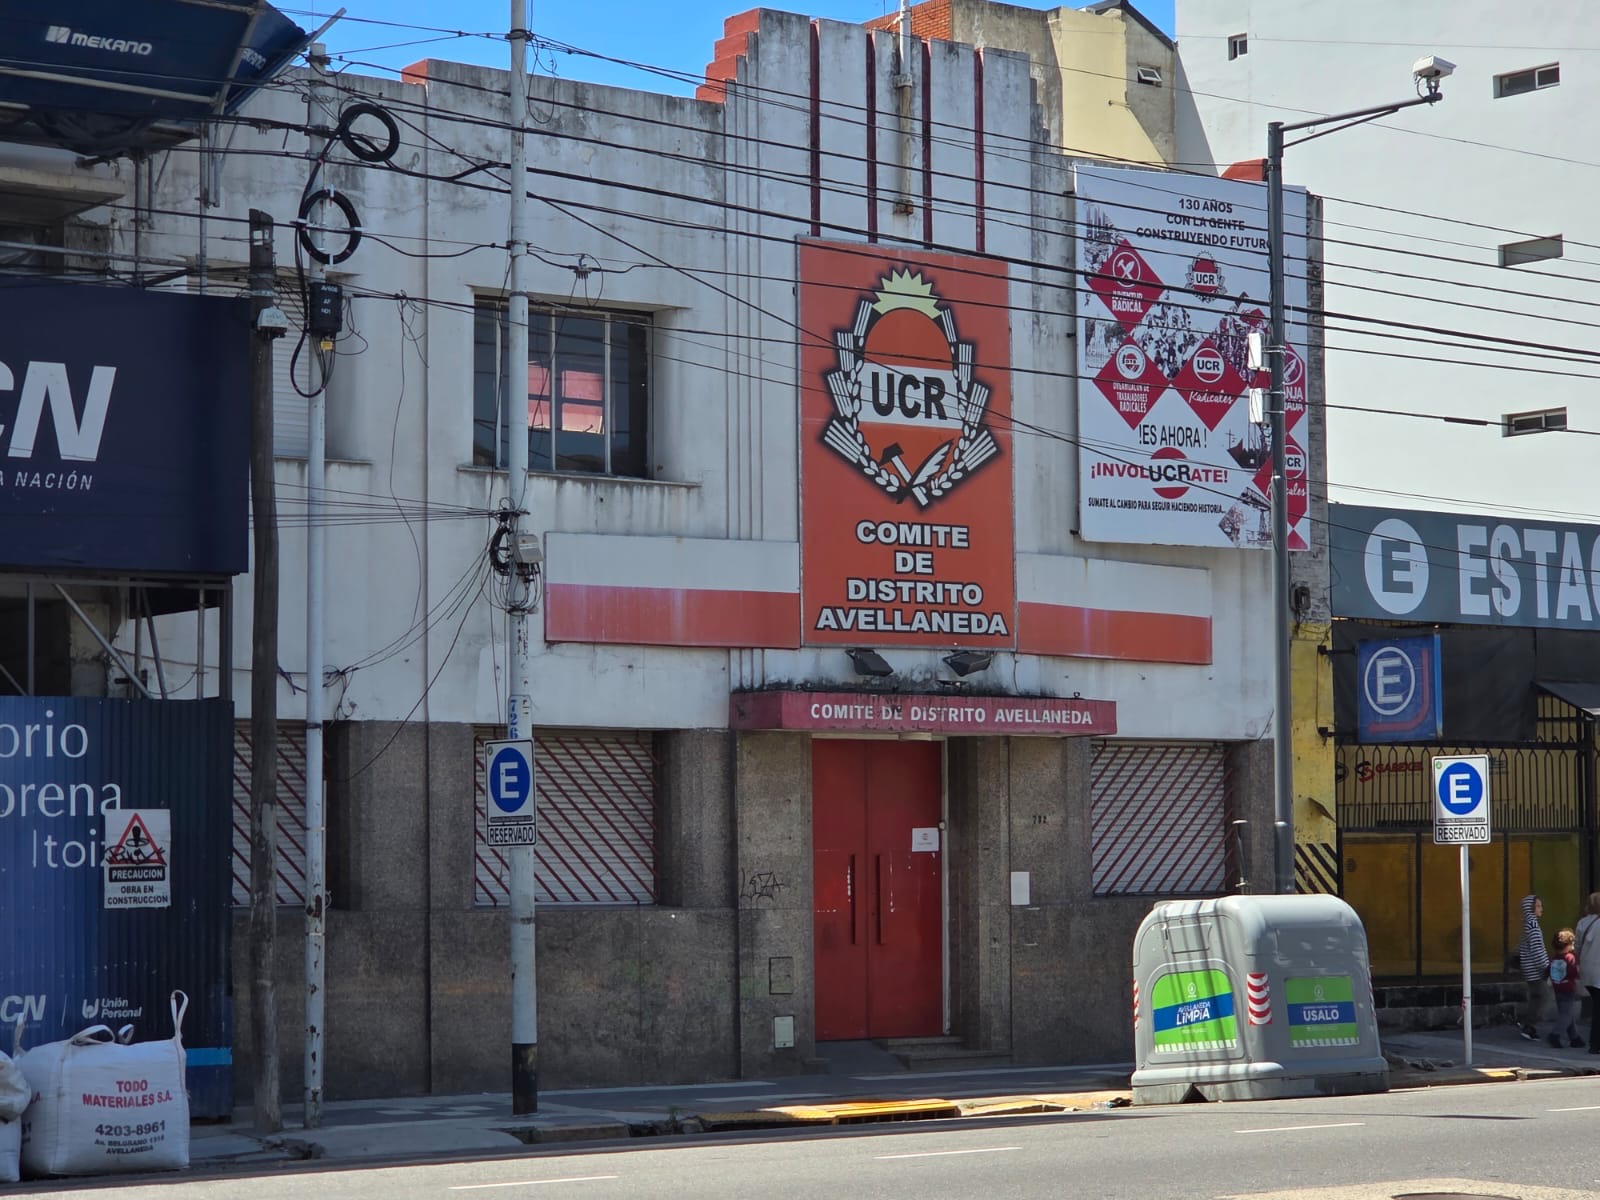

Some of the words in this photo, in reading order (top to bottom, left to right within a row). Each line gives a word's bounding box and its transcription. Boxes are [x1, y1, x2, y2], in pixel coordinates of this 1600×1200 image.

[1178, 198, 1200, 210] 130
[1202, 198, 1233, 213] AÑOS
[1166, 213, 1190, 226] CON
[1193, 216, 1206, 227] LA
[1208, 217, 1245, 231] GENTE
[1136, 227, 1228, 246] CONSTRUYENDO
[1196, 273, 1215, 285] UCR
[1112, 300, 1143, 313] RADICAL
[1197, 360, 1220, 371] UCR
[872, 371, 947, 420] UCR
[1160, 425, 1202, 448] AHORA
[1286, 456, 1302, 468] CR
[15, 469, 93, 491] NACIÓN
[1117, 500, 1137, 510] CAMBIO
[1138, 501, 1151, 511] PARA
[1152, 502, 1171, 511] SEGUIR
[1171, 503, 1198, 513] HACIENDO
[856, 520, 969, 547] COMITE
[895, 551, 933, 574] DE
[1381, 539, 1414, 595] E
[1457, 523, 1600, 621] ESTA
[847, 578, 983, 606] DISTRITO
[815, 607, 1009, 635] AVELLANEDA
[1376, 656, 1404, 705] E
[811, 703, 874, 720] COMITE
[881, 705, 903, 721] DE
[910, 706, 986, 723] DISTRITO
[995, 708, 1093, 725] AVELLANEDA
[499, 761, 520, 799] E
[1449, 773, 1472, 805] E
[490, 826, 534, 843] RESERVADO
[1437, 826, 1486, 841] RESERVADO
[111, 869, 164, 880] PRECAUCION
[121, 885, 142, 895] OBRA
[143, 885, 154, 894] EN
[107, 895, 169, 905] CONSTRUCCION
[101, 997, 129, 1009] Unión
[101, 1006, 143, 1019] Personal
[1303, 1009, 1340, 1022] USALO
[116, 1080, 149, 1094] TODO
[82, 1093, 155, 1109] MATERIALES
[95, 1120, 166, 1137] 4203-8961
[106, 1144, 154, 1155] AVELLANEDA
